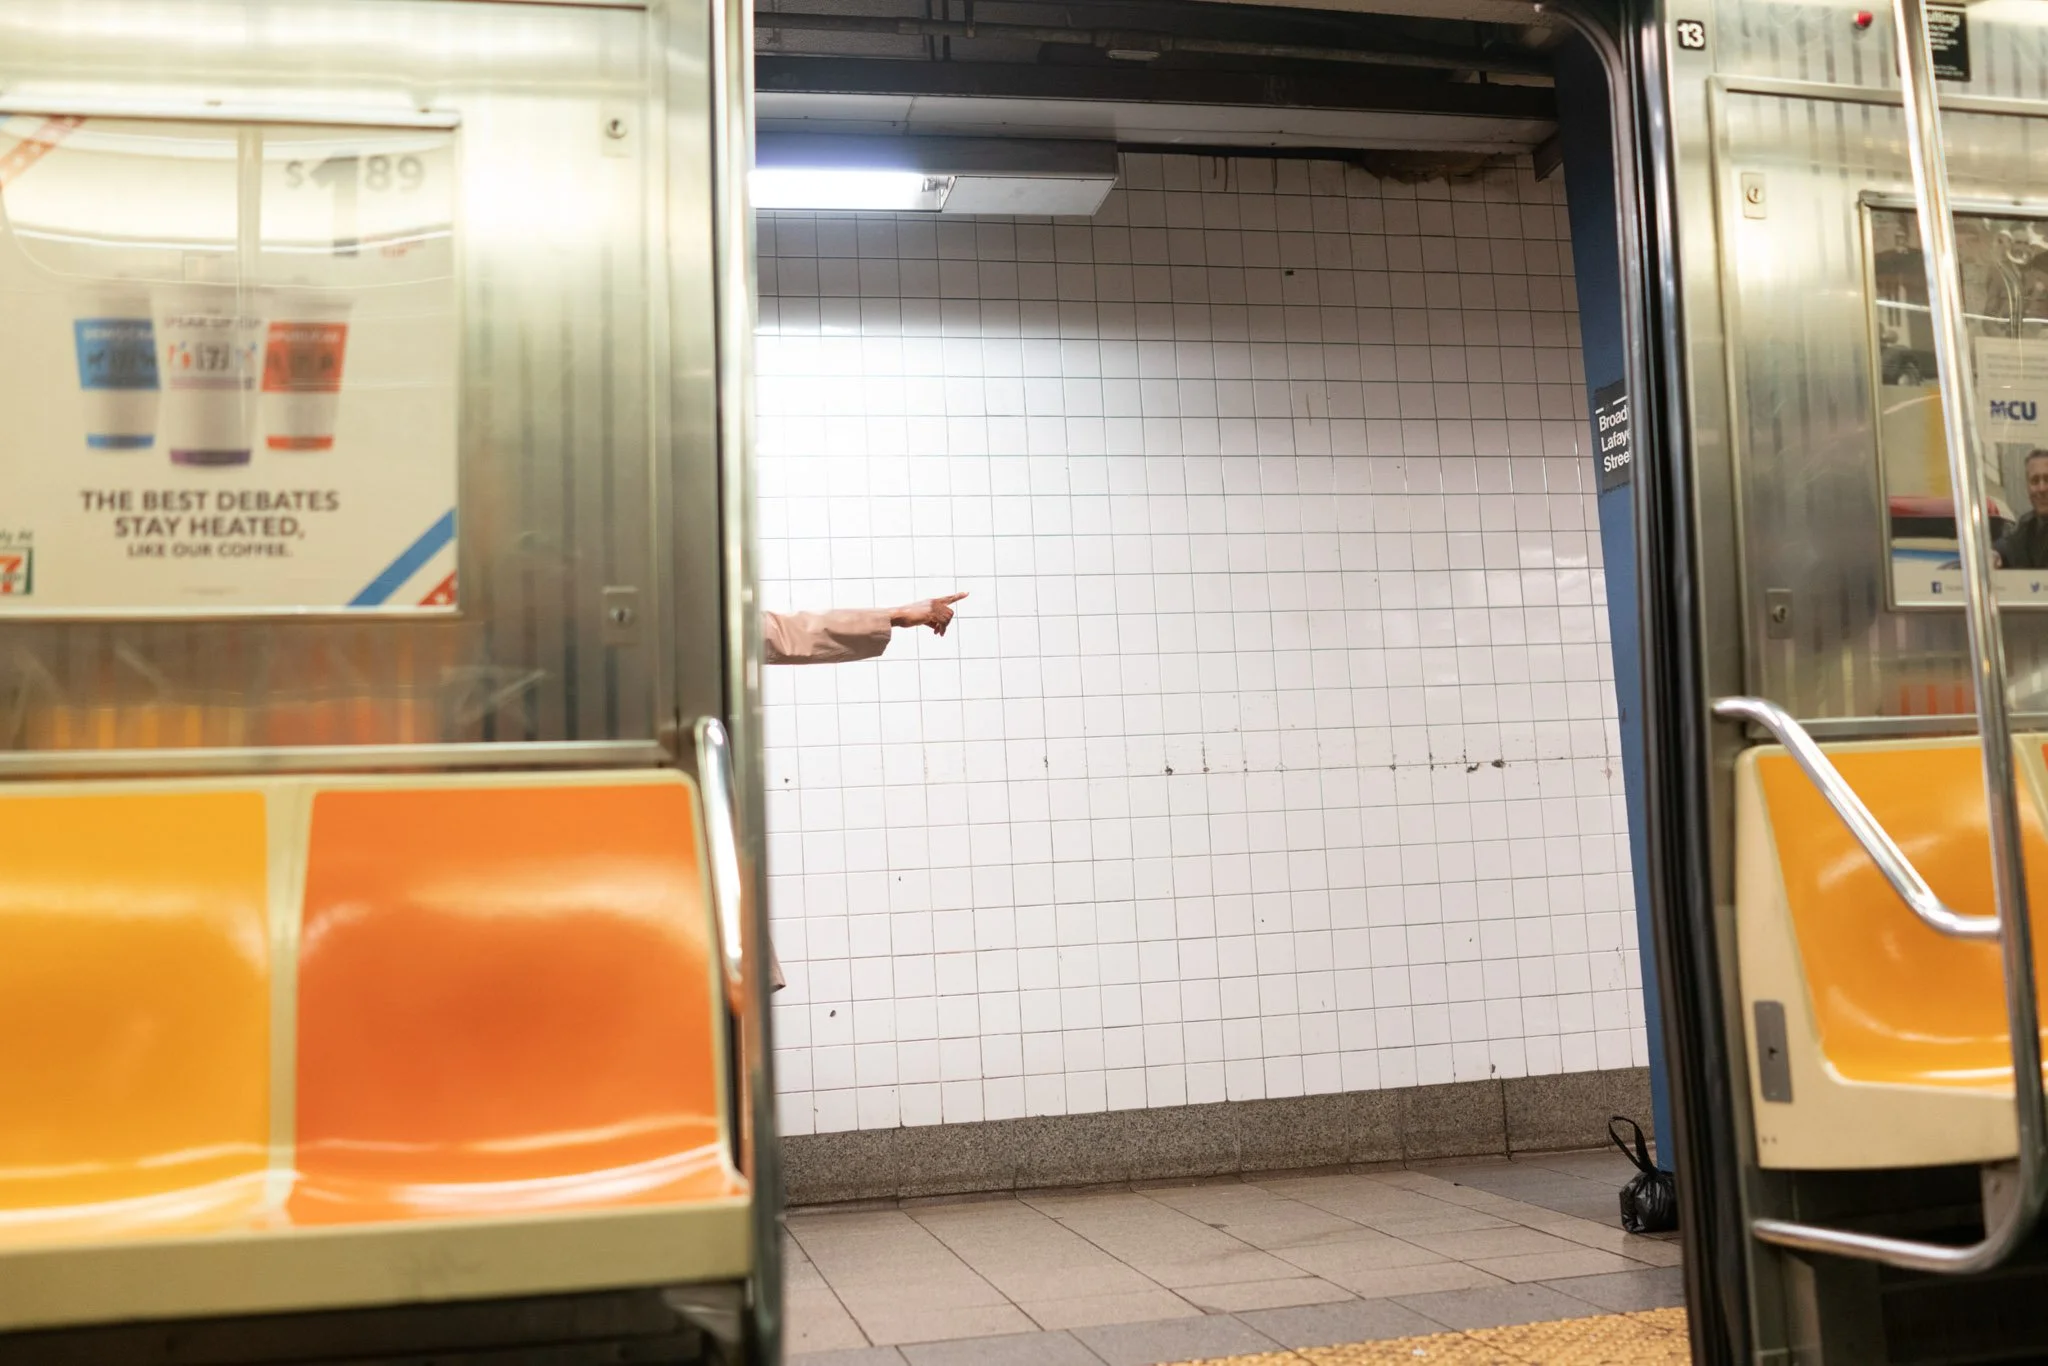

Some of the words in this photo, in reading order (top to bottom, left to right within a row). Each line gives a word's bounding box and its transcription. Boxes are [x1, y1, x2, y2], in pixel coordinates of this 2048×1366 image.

[1678, 22, 1705, 48] 13
[1991, 400, 2036, 421] MCU
[1604, 447, 1632, 472] Stree
[81, 490, 132, 512] THE
[142, 490, 208, 512] BEST
[217, 490, 339, 512] DEBATES
[115, 516, 181, 538] STAY
[189, 516, 305, 540] HEATED,
[127, 542, 166, 558] LIKE
[172, 542, 212, 558] OUR
